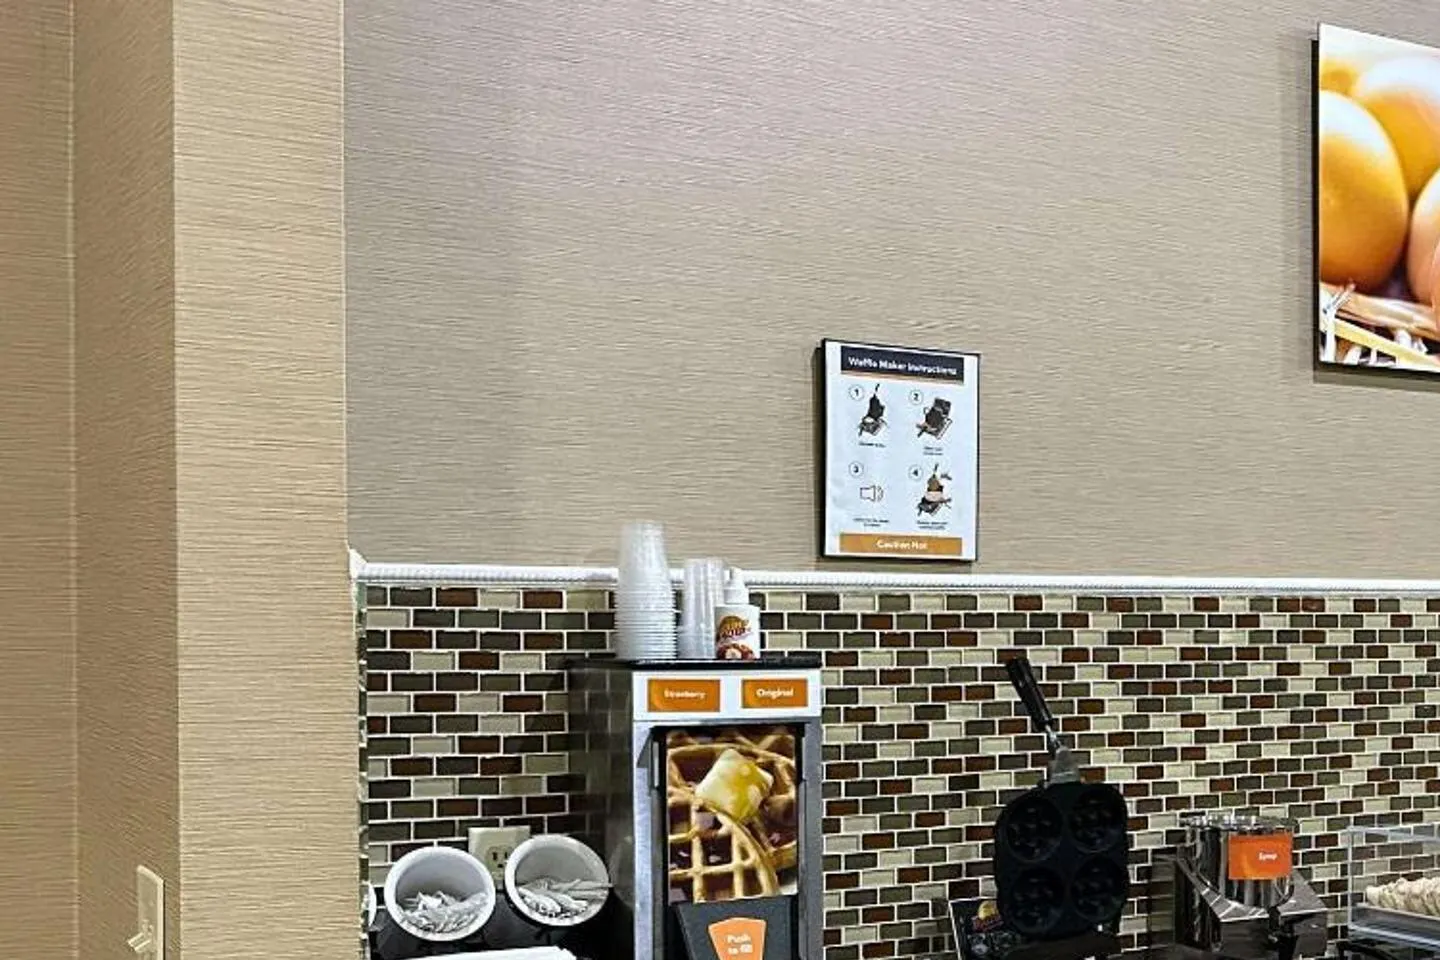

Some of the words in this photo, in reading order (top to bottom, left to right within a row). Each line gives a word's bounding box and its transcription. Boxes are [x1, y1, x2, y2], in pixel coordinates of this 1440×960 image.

[848, 356, 878, 368] Waffle
[879, 360, 907, 370] Maker
[907, 362, 957, 375] Instructions
[876, 539, 911, 549] Caution
[756, 687, 794, 699] Original
[727, 933, 752, 944] Push
